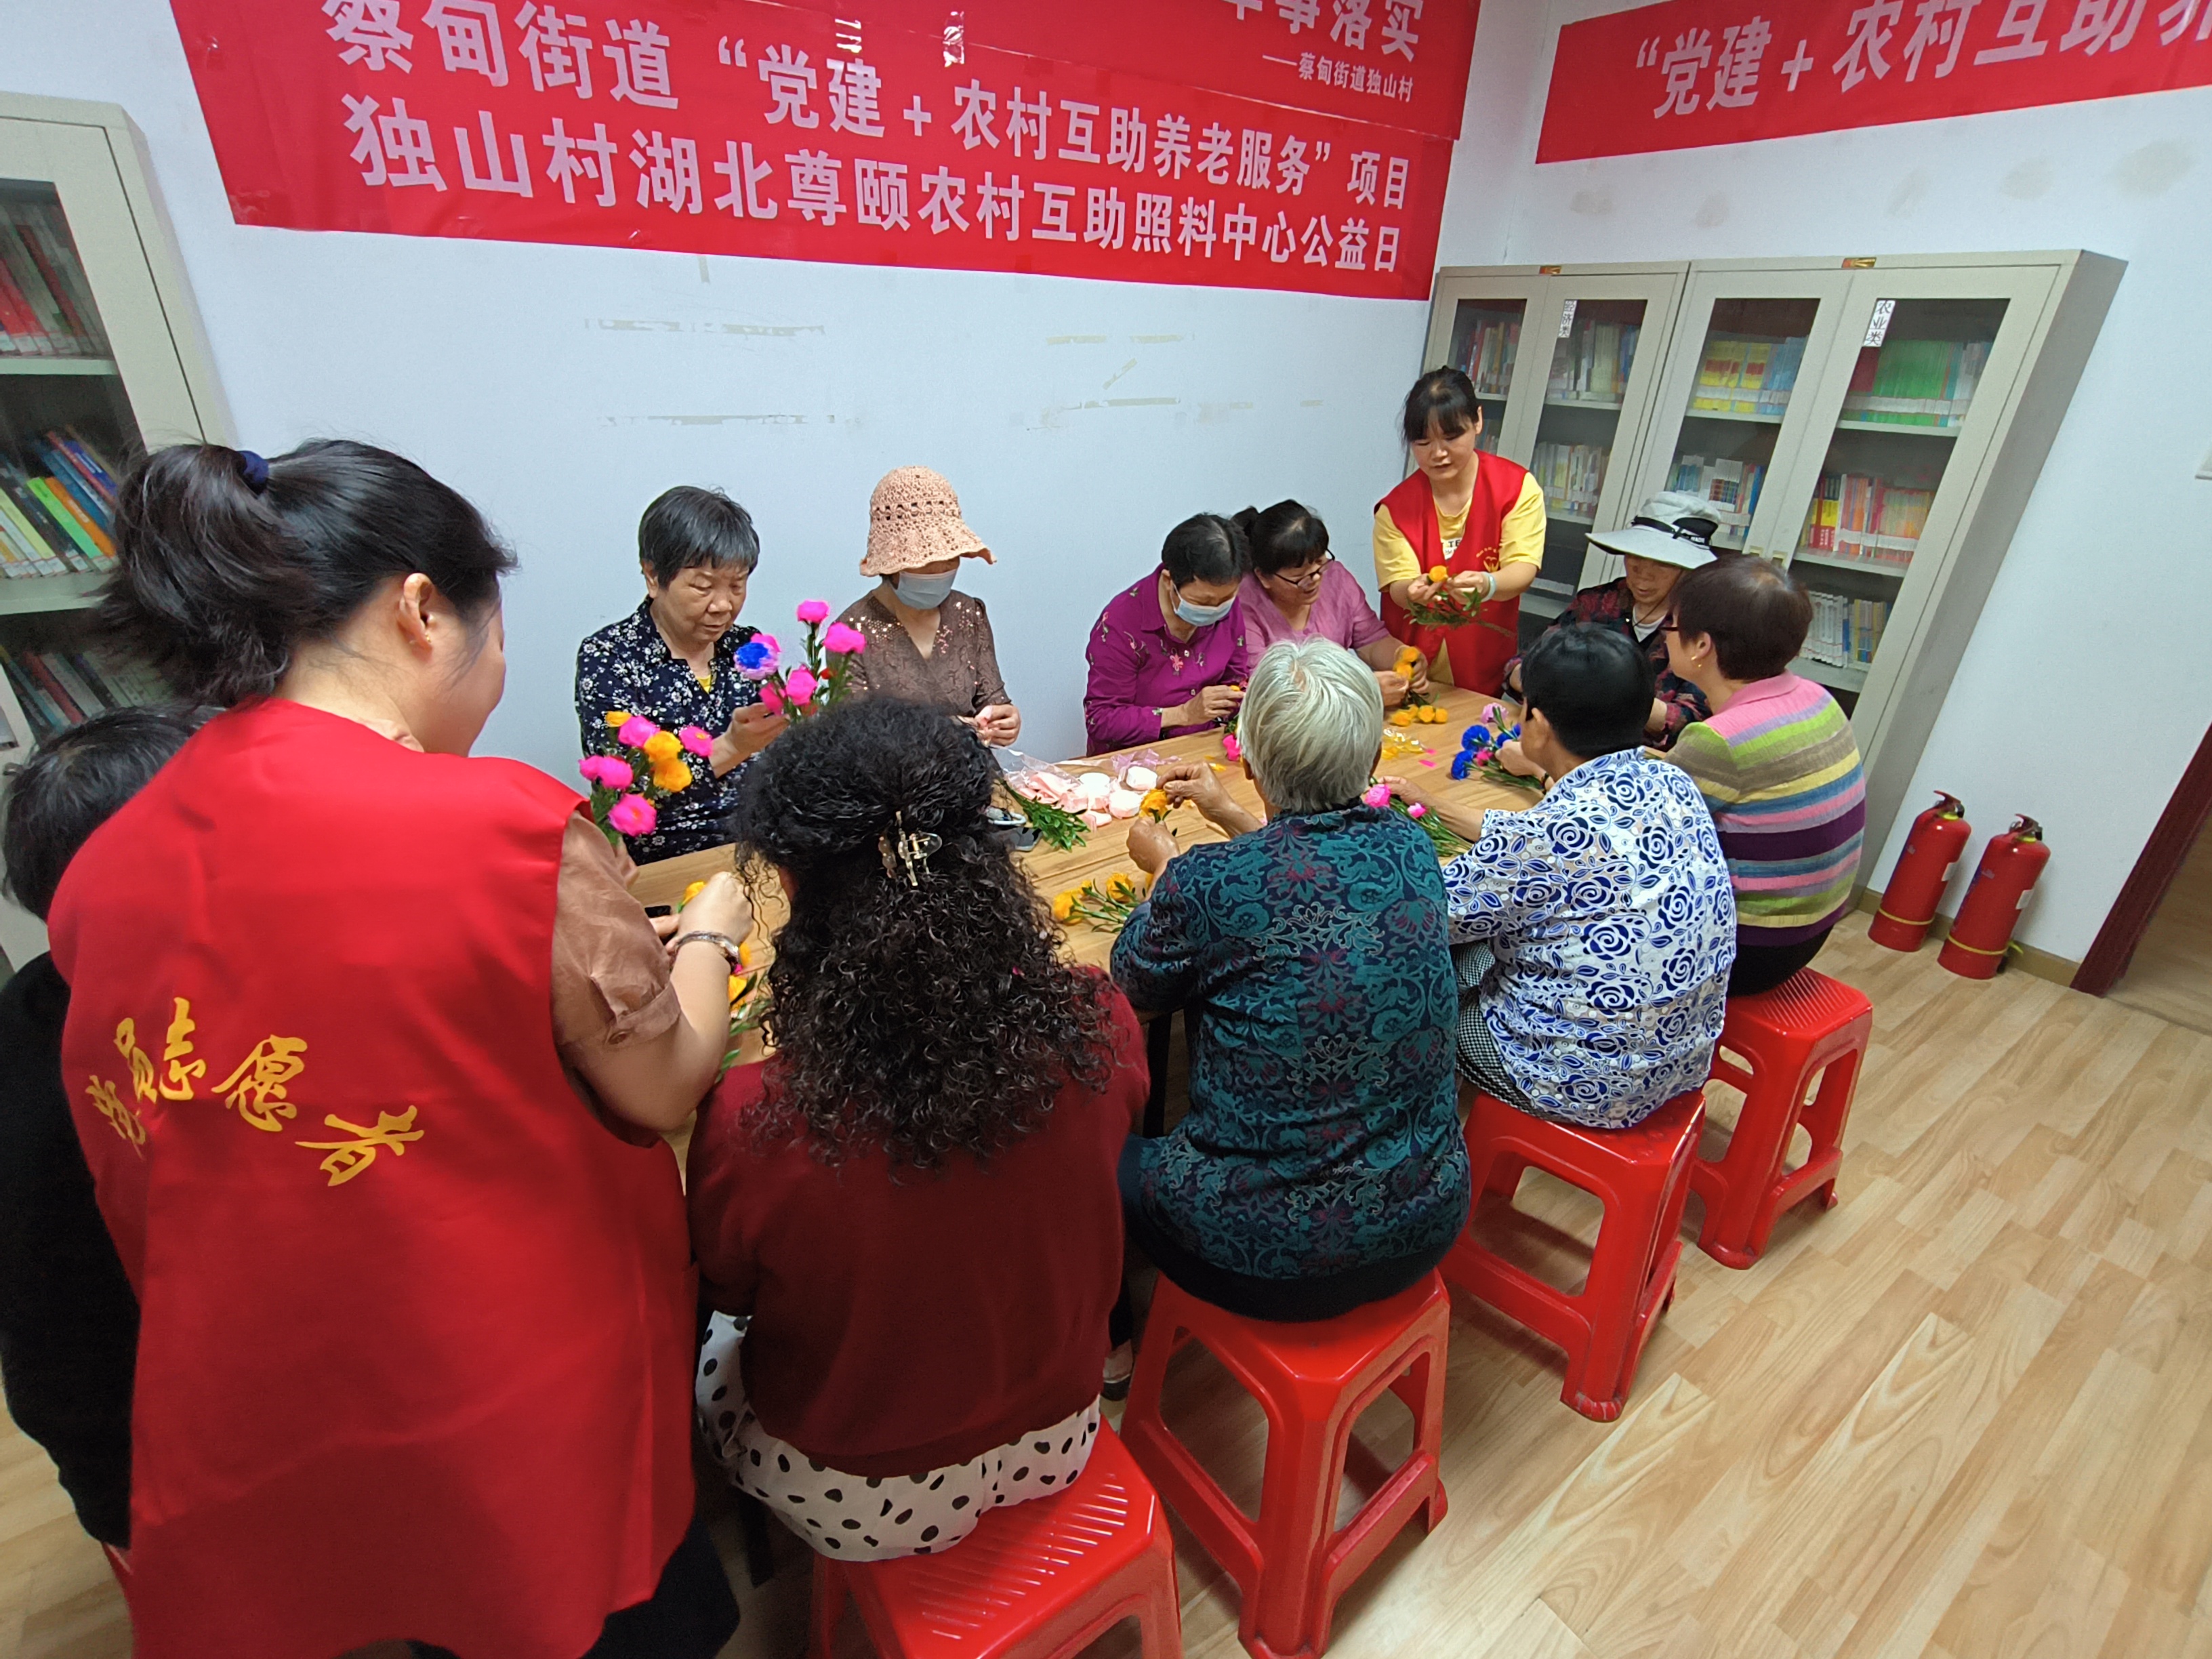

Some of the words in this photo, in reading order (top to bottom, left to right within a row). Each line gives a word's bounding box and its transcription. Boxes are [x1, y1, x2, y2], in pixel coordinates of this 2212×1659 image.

[342, 94, 1399, 272] 独山村湖北尊颐农村互助照料中心公益日
[1865, 300, 1892, 345] 农业类
